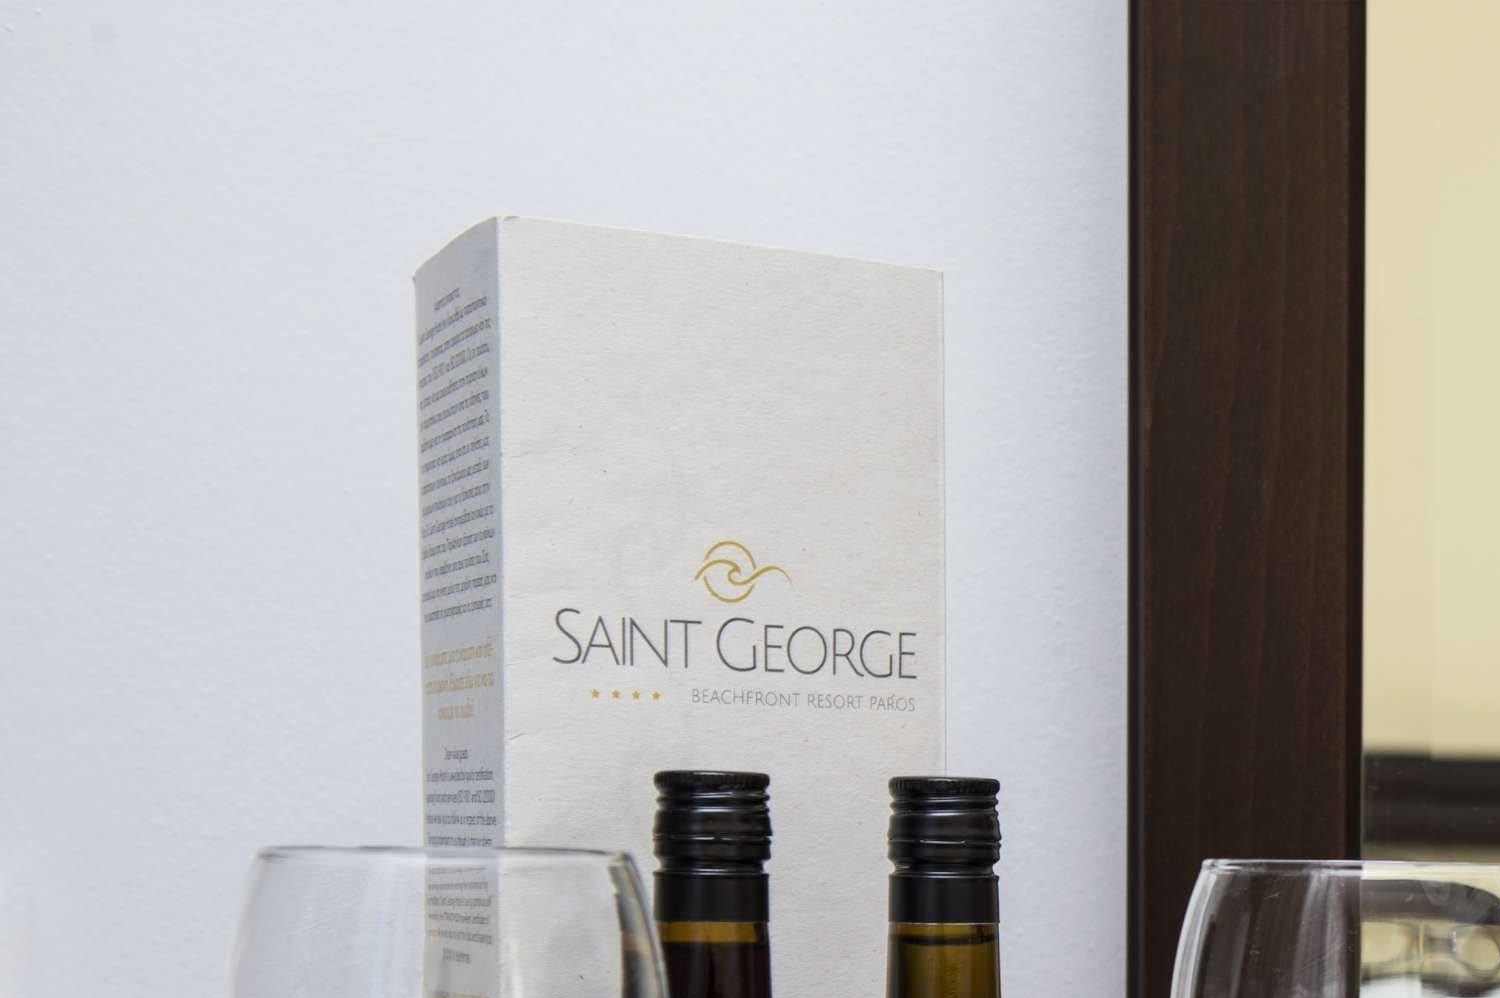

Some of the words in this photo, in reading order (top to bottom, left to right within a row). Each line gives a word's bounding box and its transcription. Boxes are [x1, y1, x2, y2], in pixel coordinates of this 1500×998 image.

[553, 608, 702, 668] SAINT
[716, 617, 917, 679] GEORGE
[691, 688, 800, 708] BEACHFRONT
[808, 693, 863, 710] RESORT
